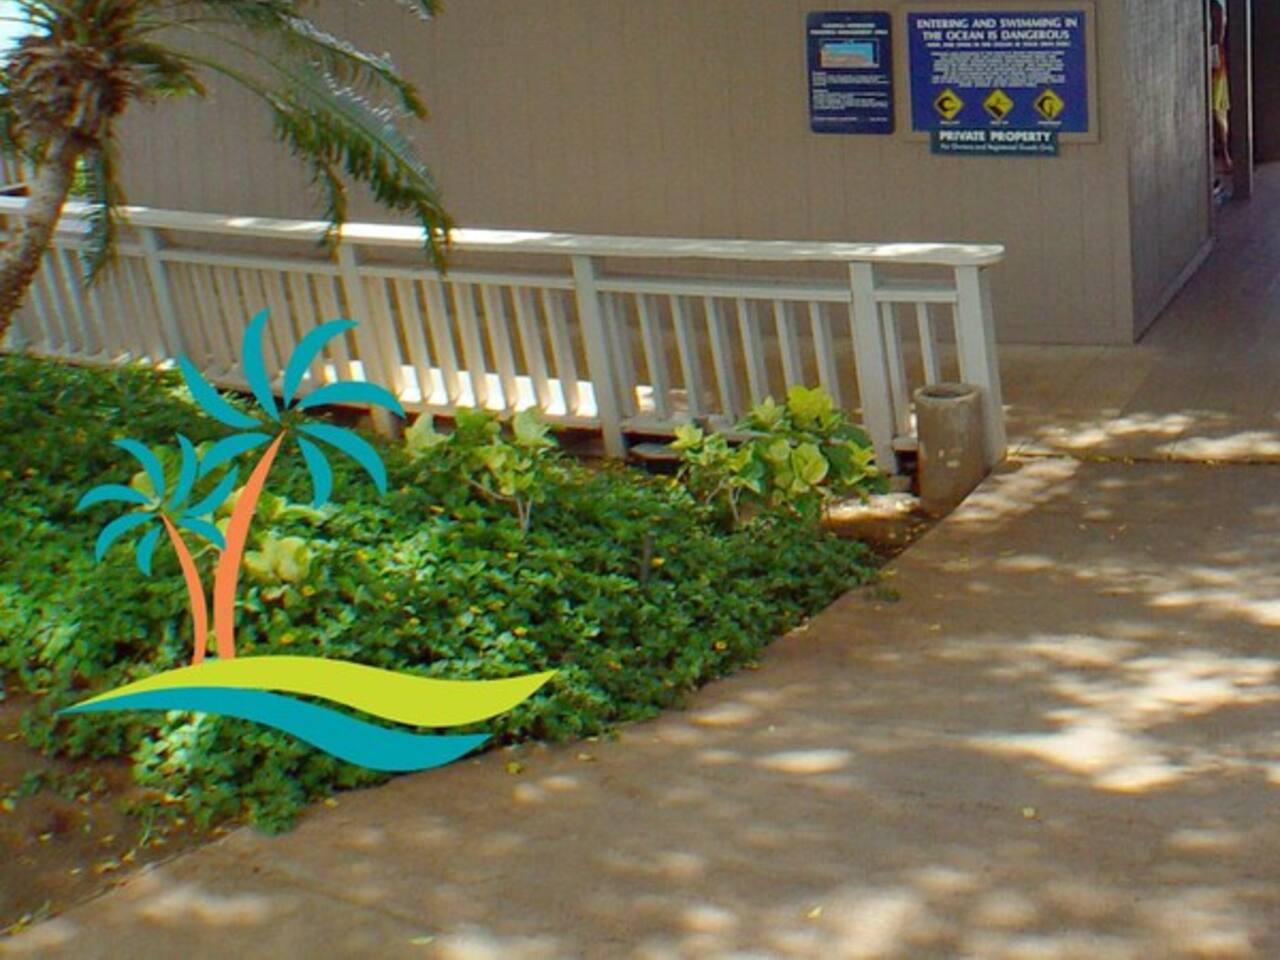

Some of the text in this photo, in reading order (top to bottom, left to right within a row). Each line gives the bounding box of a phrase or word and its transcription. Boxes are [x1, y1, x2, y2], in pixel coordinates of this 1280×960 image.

[916, 17, 1078, 29] ENTERING AND SWIMMING IN
[923, 29, 1070, 41] THE OCEAN IS DANGEROUS
[939, 131, 1052, 142] PRIVATE PROPERTY
